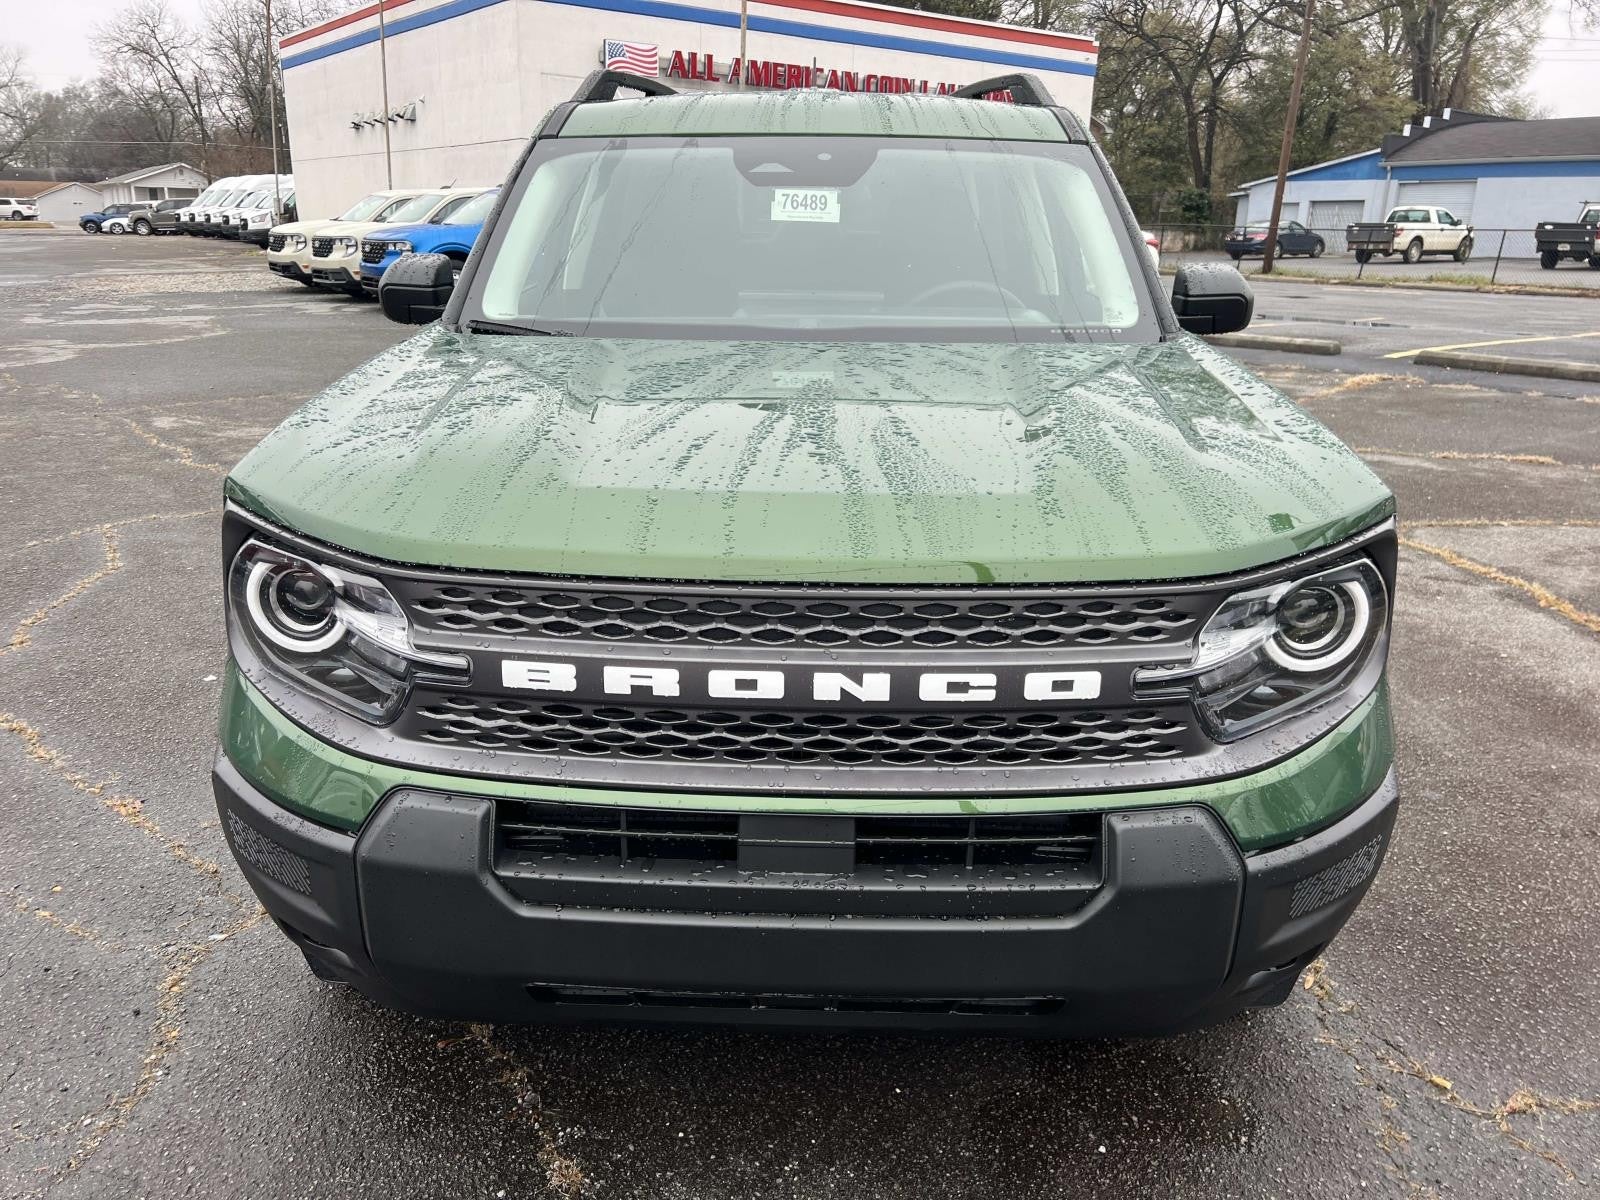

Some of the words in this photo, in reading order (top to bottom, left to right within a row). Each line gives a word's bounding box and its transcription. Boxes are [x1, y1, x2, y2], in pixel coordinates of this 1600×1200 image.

[667, 50, 720, 82] ALL
[781, 193, 828, 211] 76489
[501, 659, 1101, 702] BRONCO
